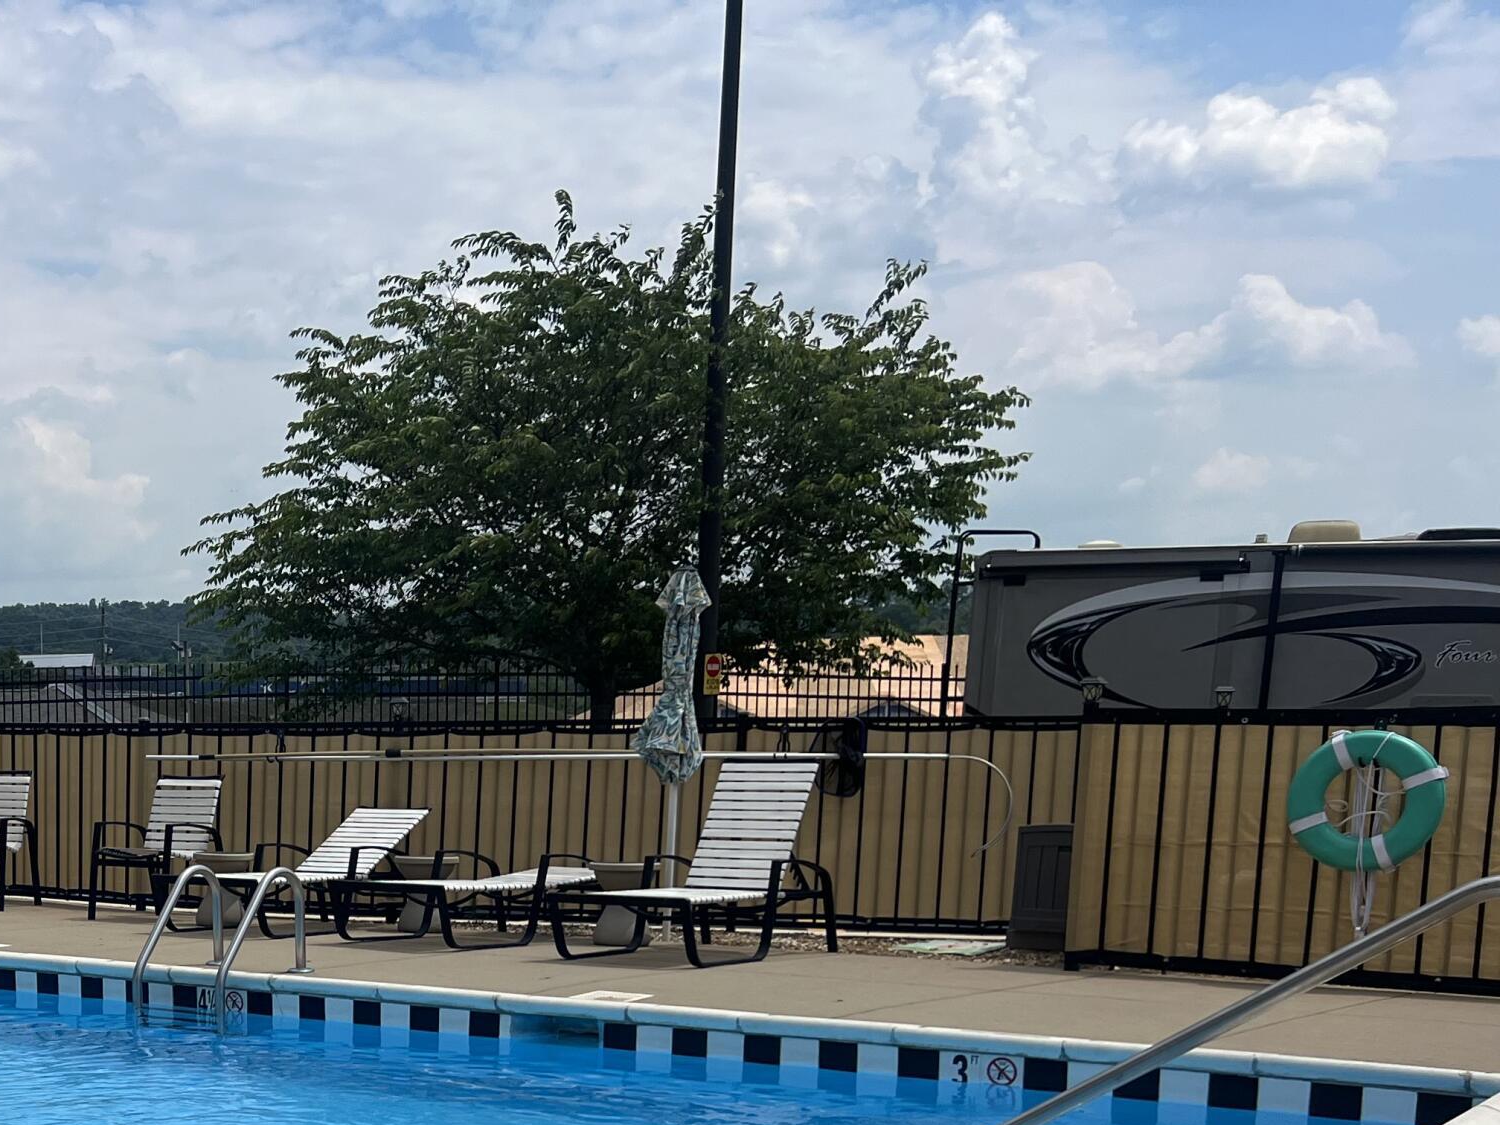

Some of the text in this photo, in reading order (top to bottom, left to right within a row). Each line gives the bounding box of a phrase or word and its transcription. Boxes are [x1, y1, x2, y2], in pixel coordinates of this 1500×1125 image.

[1435, 640, 1498, 668] Four
[951, 1054, 979, 1083] 3 FT
